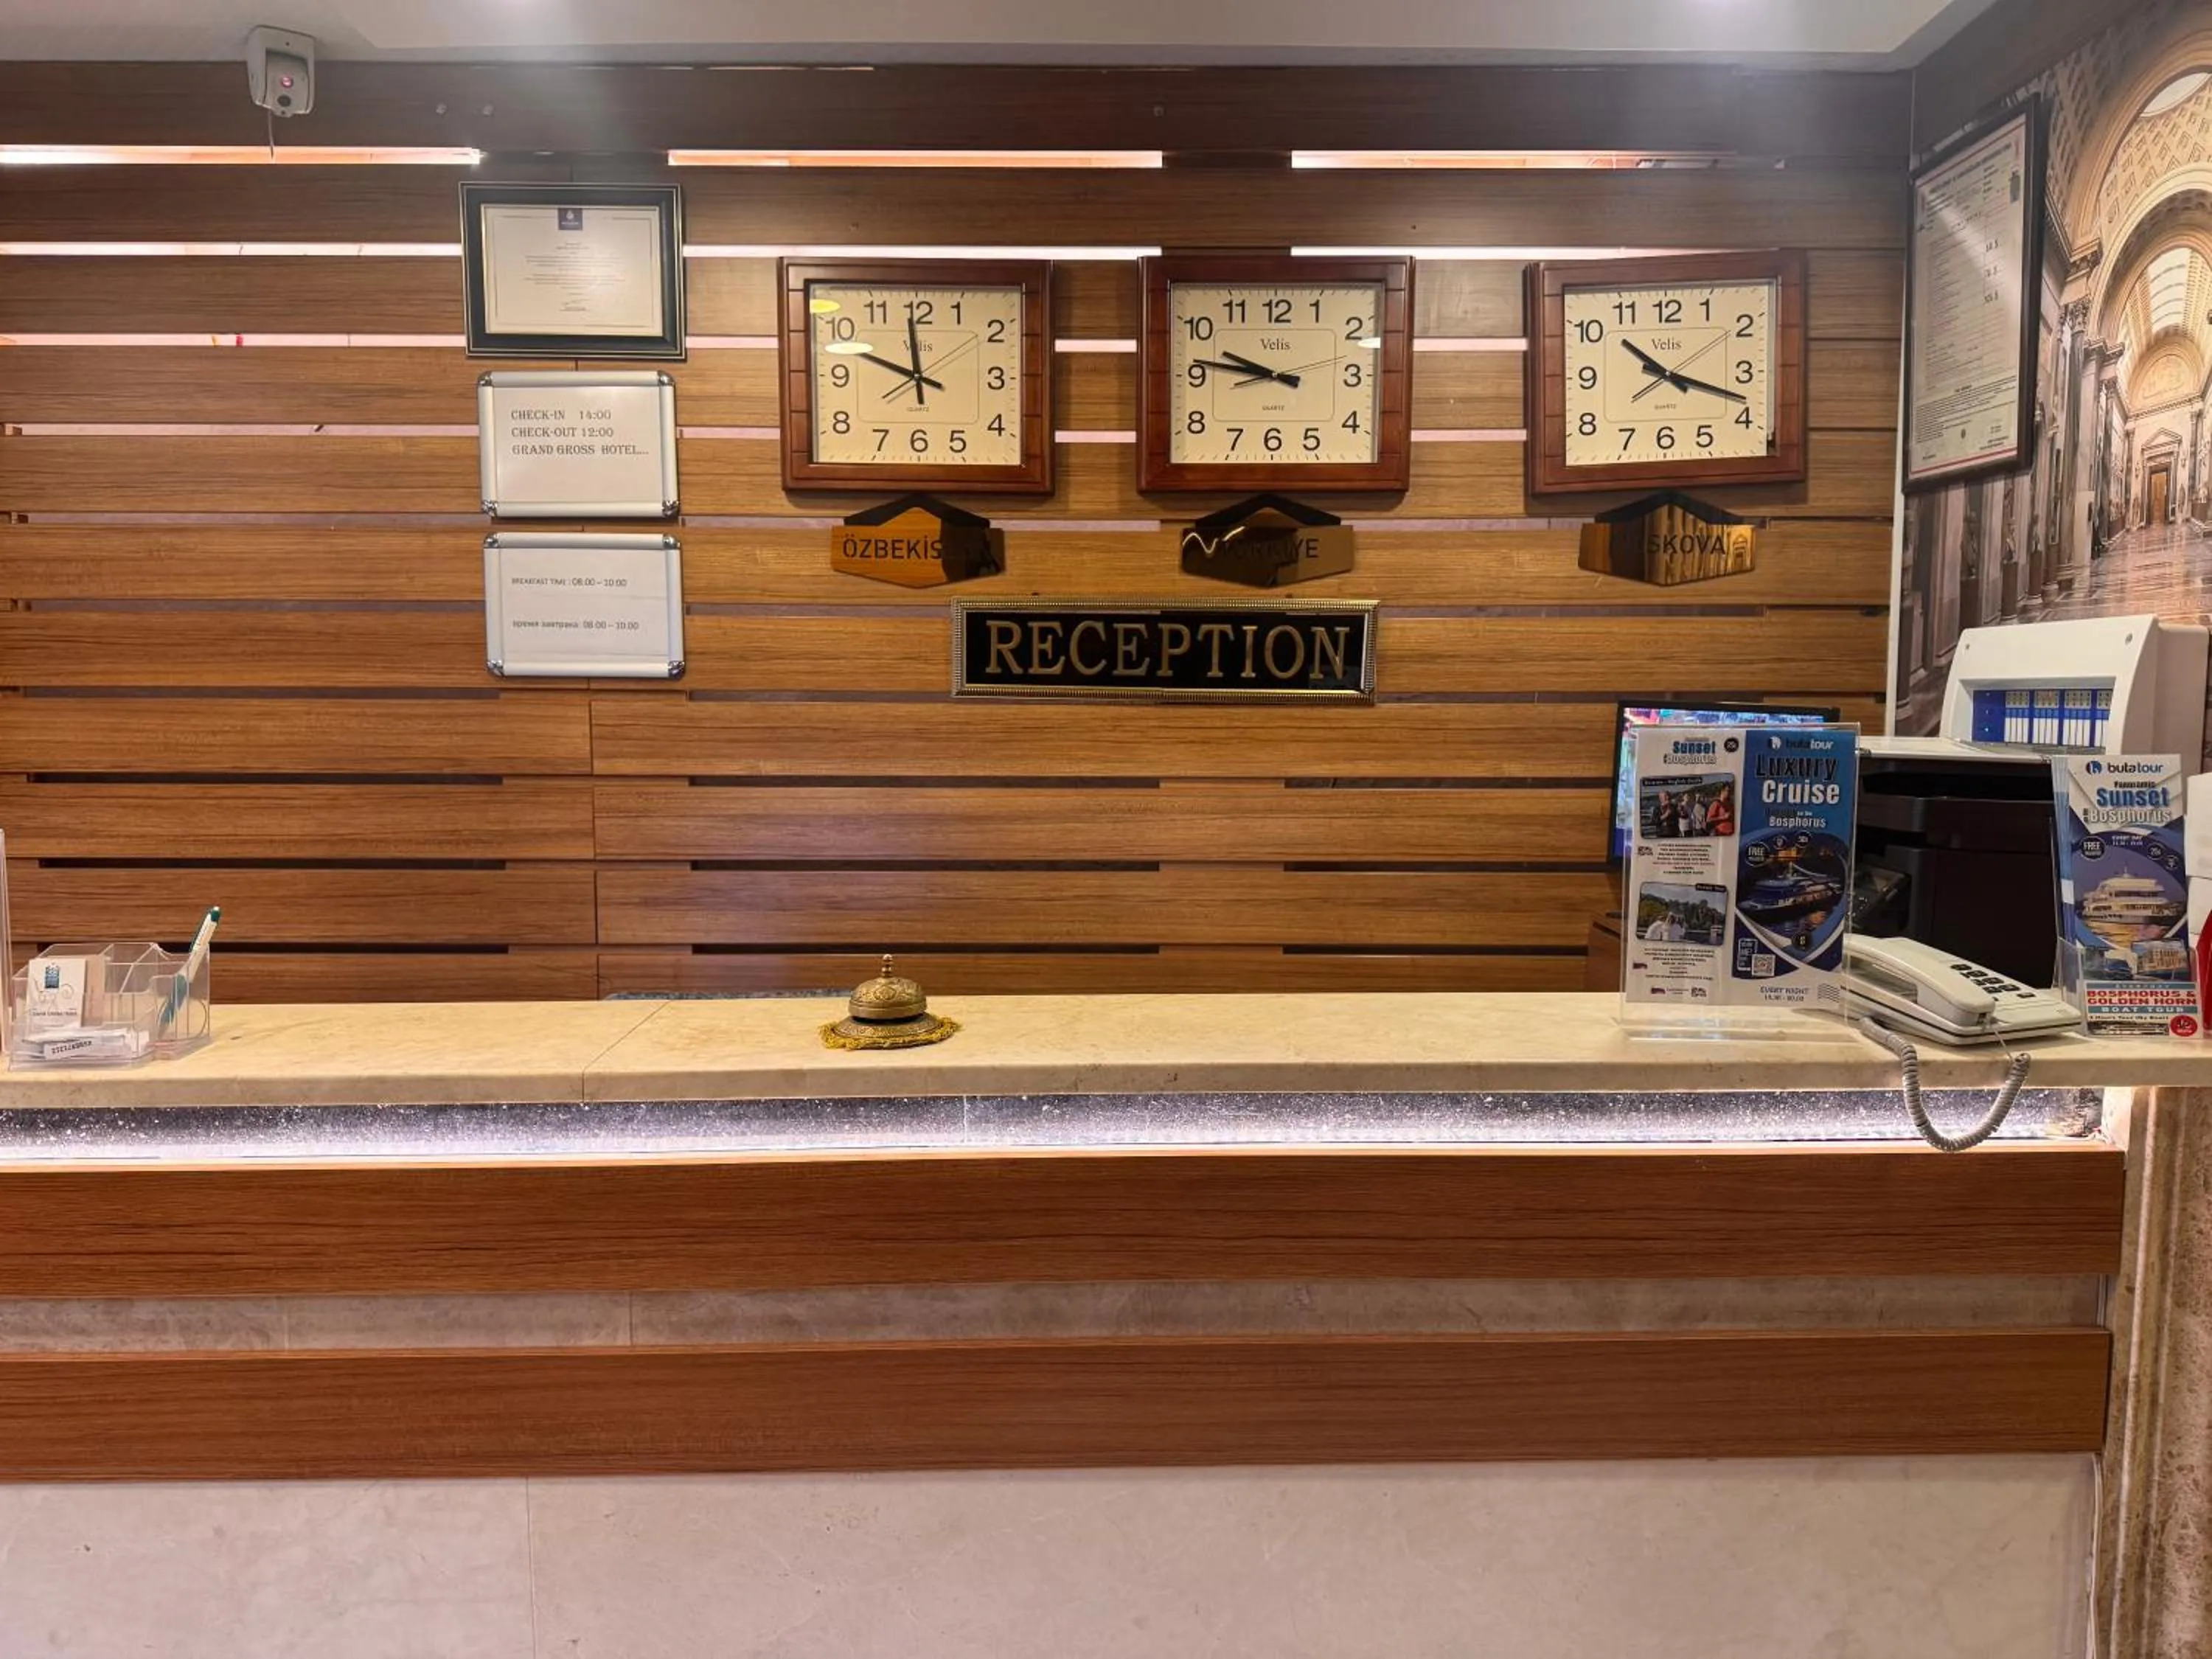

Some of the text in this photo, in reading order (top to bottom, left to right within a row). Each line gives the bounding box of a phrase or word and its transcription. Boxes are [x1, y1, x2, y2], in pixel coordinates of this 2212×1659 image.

[863, 301, 887, 324] 11
[903, 301, 933, 324] 12
[950, 301, 961, 324] 1
[1222, 299, 1246, 323] 11
[1262, 299, 1292, 323] 12
[1309, 299, 1320, 323] 1
[1612, 301, 1635, 324] 11
[1652, 299, 1683, 324] 12
[1699, 299, 1710, 321] 1
[825, 317, 855, 341] 10
[987, 319, 1005, 343] 2
[1183, 316, 1214, 341] 10
[1344, 316, 1363, 340] 2
[1573, 319, 1604, 343] 10
[1735, 314, 1754, 338] 2
[902, 340, 933, 352] Vlis
[1259, 338, 1291, 351] Velis
[1651, 337, 1683, 351] Velis
[831, 364, 849, 388] 9
[987, 366, 1005, 390] 3
[1188, 364, 1206, 388] 9
[1343, 364, 1361, 387] 3
[1578, 366, 1597, 390] 9
[1735, 361, 1753, 384] 3
[511, 409, 566, 420] CHECK-IN
[832, 411, 850, 434] 8
[987, 414, 1006, 437] 4
[1186, 411, 1206, 434] 8
[1341, 411, 1360, 434] 4
[1578, 412, 1596, 437] 8
[1733, 407, 1753, 430] 4
[511, 427, 614, 438] CHECK-OUT 12:00
[872, 429, 889, 451] 7
[910, 429, 928, 453] 6
[949, 430, 967, 453] 5
[1226, 428, 1244, 451] 7
[1263, 428, 1282, 451] 6
[1302, 428, 1321, 451] 5
[1618, 428, 1636, 451] 7
[1656, 426, 1675, 450] 6
[1695, 425, 1714, 448] 5
[512, 444, 554, 456] GRAND
[556, 445, 596, 455] GROSS
[843, 534, 944, 560] ÖZBEKİS
[1646, 533, 1727, 555] SKOVA
[984, 619, 1351, 681] RECEPTION
[1673, 740, 1717, 754] Sunset
[1755, 753, 1839, 782] Luxury
[2107, 762, 2164, 773] butatour
[1761, 779, 1841, 805] Cruise
[2096, 787, 2170, 807] Sunset
[1769, 815, 1827, 828] Bosphorus
[2090, 809, 2171, 824] Bosphorus
[2083, 841, 2101, 851] FREE
